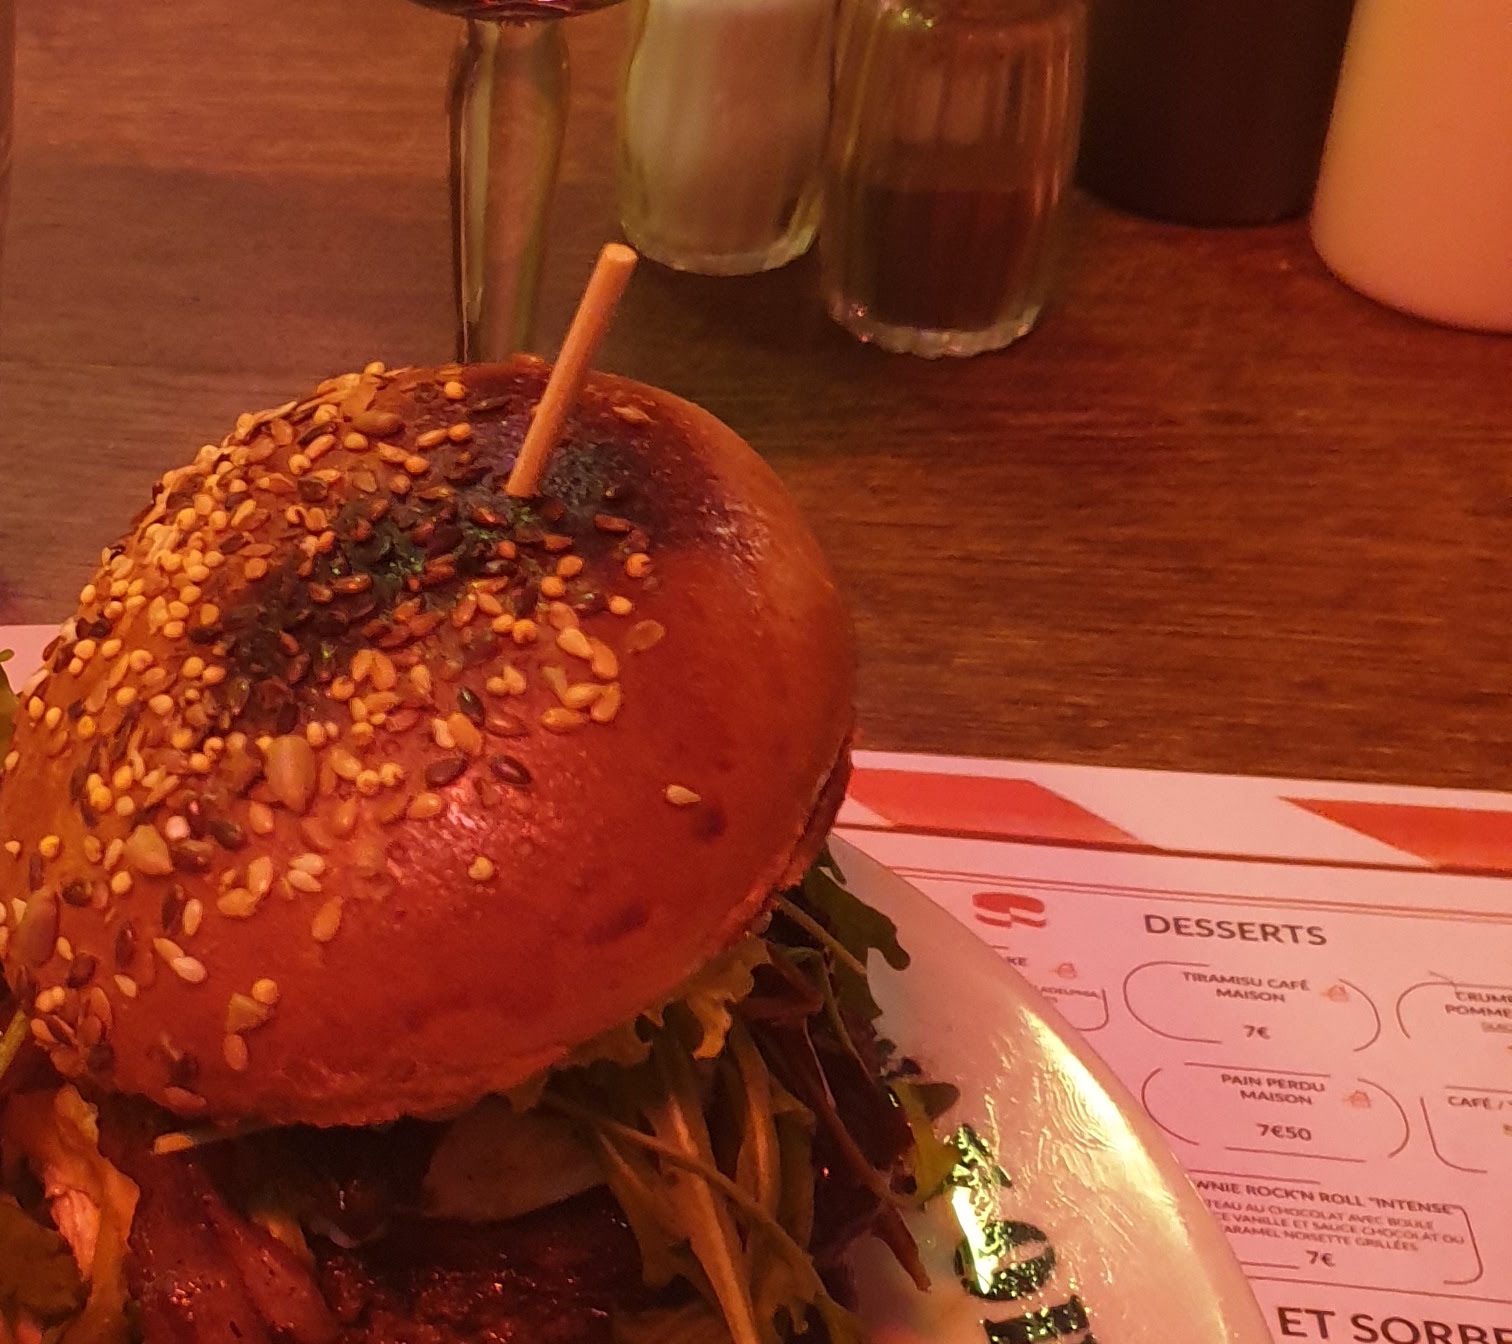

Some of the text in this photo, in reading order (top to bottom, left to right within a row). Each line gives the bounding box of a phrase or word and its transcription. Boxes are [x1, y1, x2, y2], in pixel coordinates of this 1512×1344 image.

[1144, 913, 1329, 946] DESSERTS
[1182, 971, 1263, 988] TIRAMISU
[1215, 988, 1286, 1003] MAISON
[1243, 1024, 1272, 1041] 7€
[1221, 1073, 1326, 1093] PAIN PERDU
[1240, 1089, 1313, 1106] MAISON
[1256, 1122, 1313, 1142] 7€50
[1319, 1191, 1365, 1207] ROLL
[1305, 1249, 1337, 1268] 7€
[1277, 1306, 1336, 1341] ET
